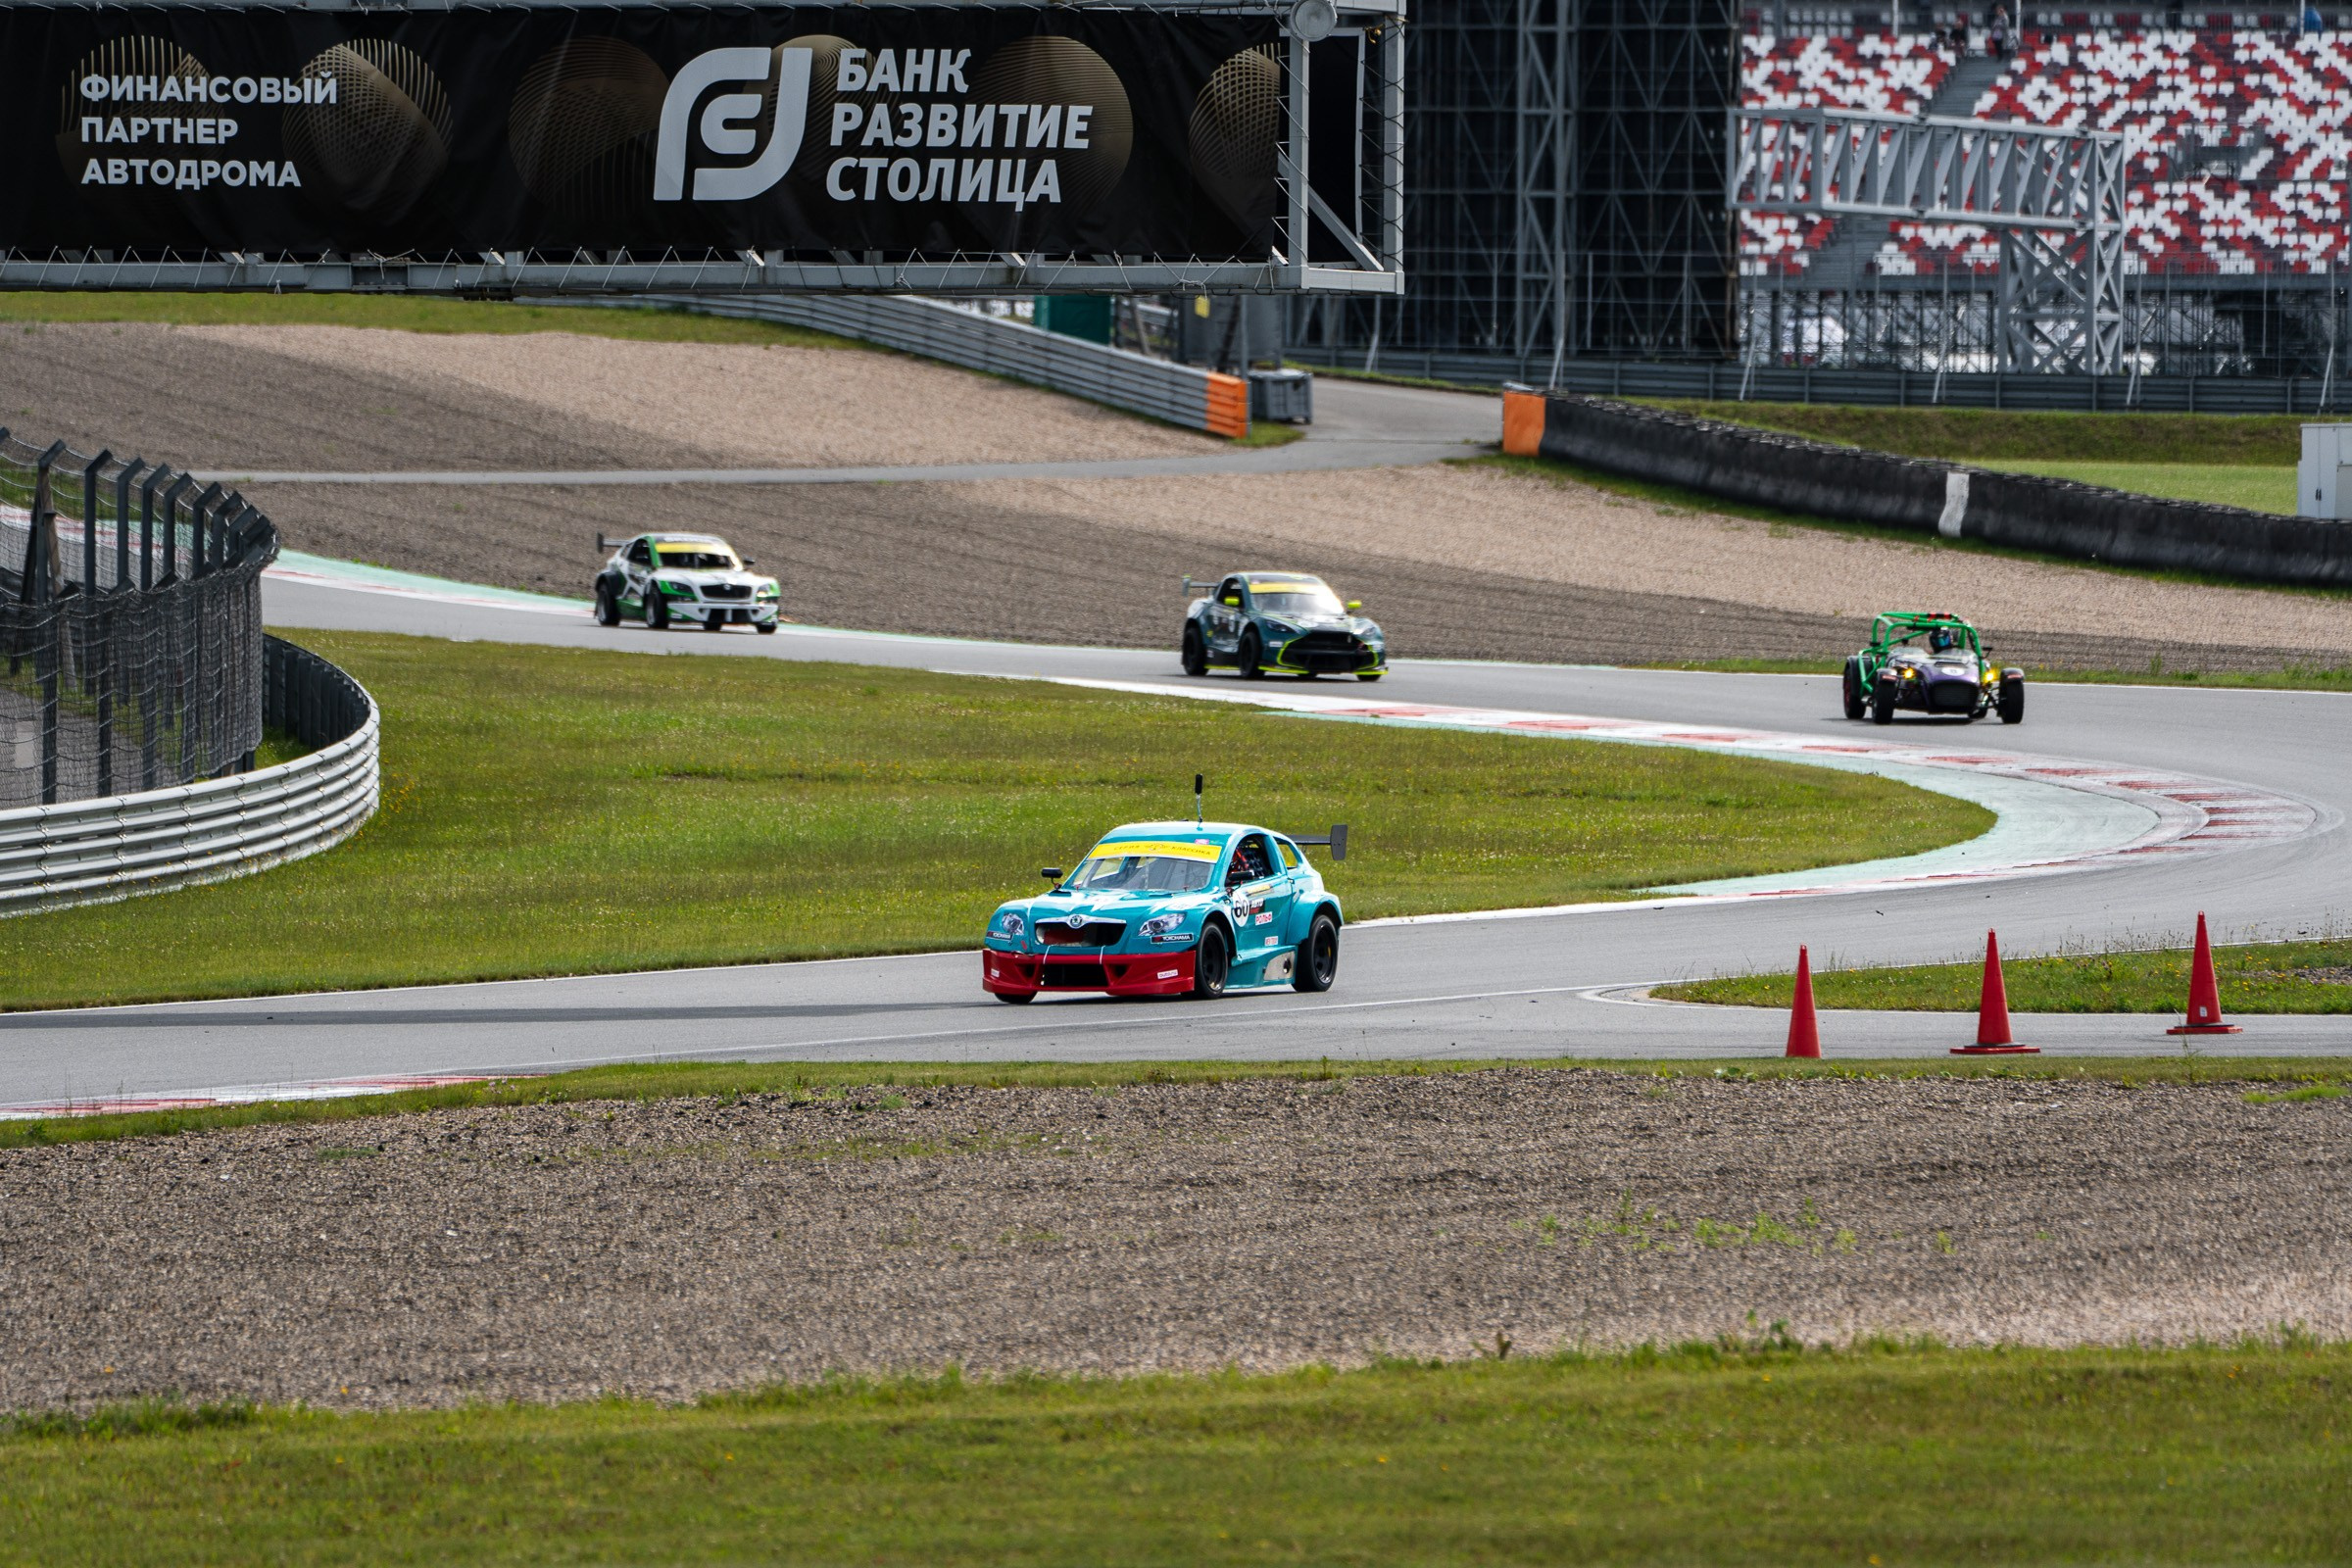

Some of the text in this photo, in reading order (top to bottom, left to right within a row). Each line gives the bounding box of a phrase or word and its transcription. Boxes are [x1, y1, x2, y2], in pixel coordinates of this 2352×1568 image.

[836, 48, 971, 93] БАНК
[79, 71, 337, 104] ФИНАНСОВЫЙ
[81, 117, 238, 144] ПАРТНЕР
[830, 103, 1094, 149] РАЗВИТИЕ
[80, 158, 302, 190] АВТОДРОМА
[826, 157, 1061, 212] СТОЛИЦА
[1234, 900, 1249, 918] 60
